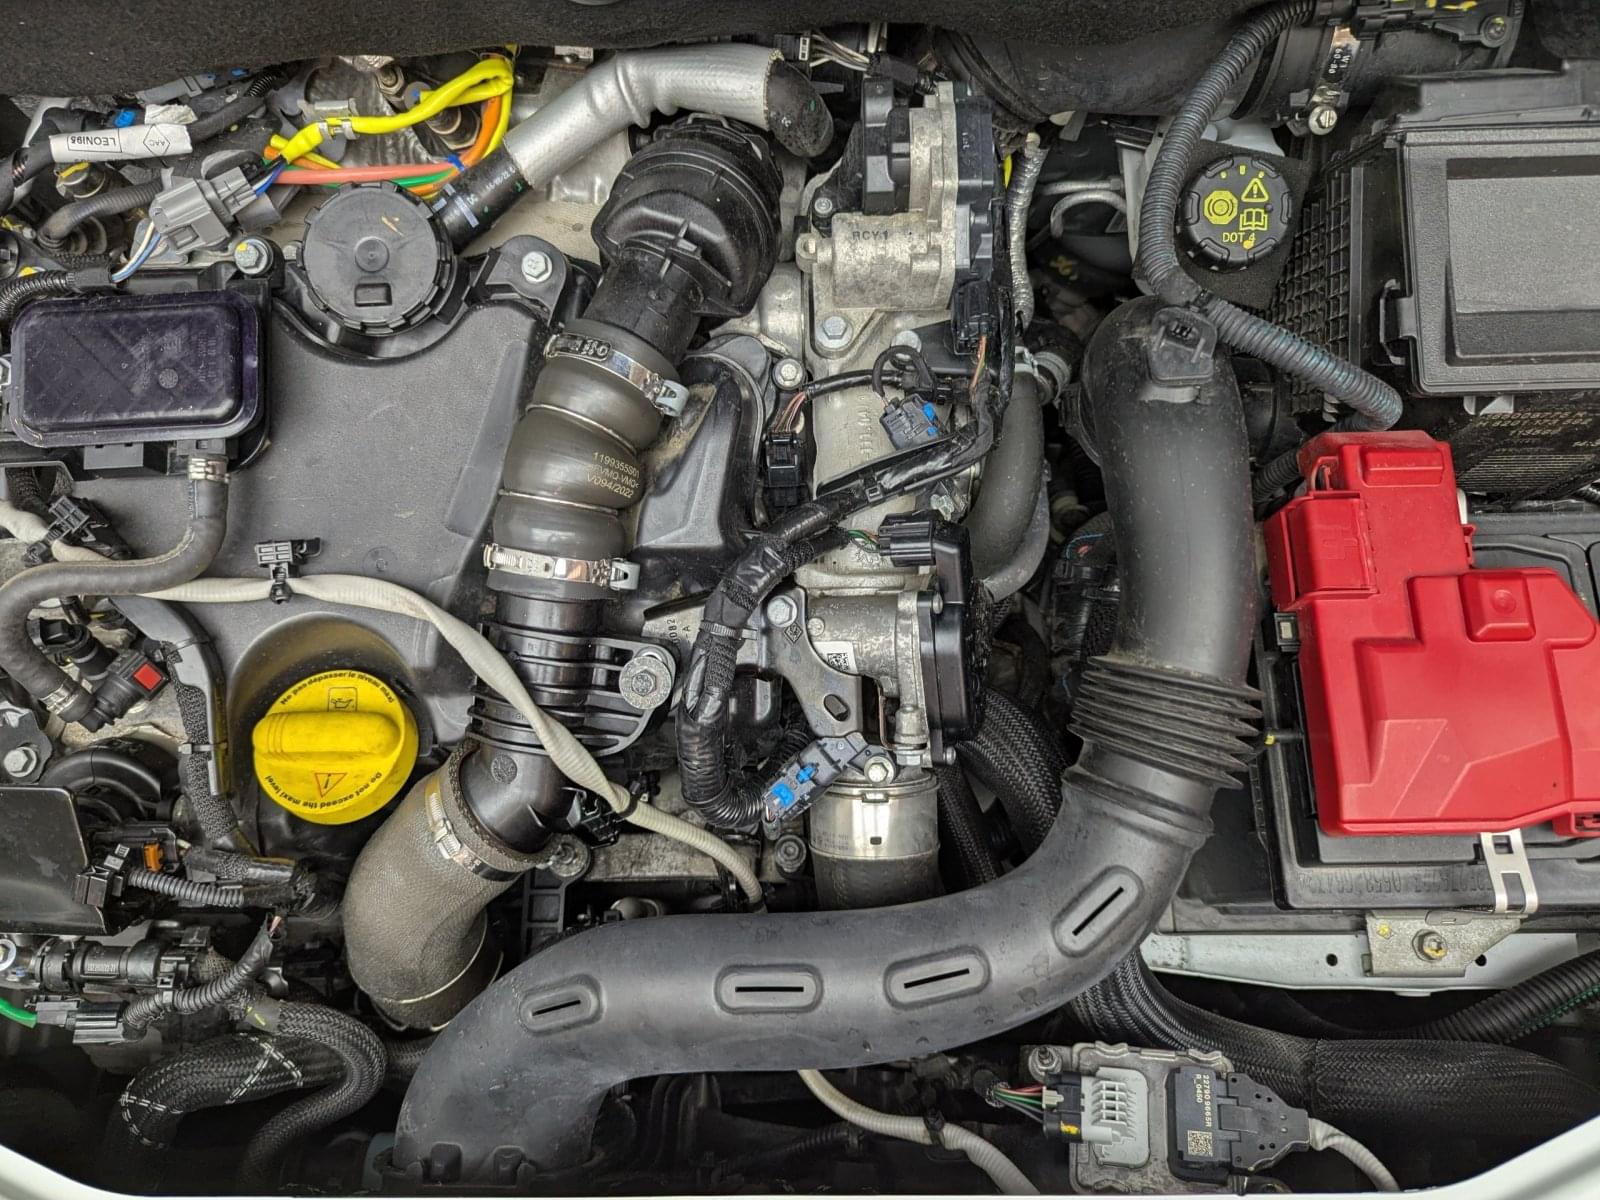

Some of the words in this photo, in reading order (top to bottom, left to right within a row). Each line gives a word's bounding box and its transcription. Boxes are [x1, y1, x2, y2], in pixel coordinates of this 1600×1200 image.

[1222, 232, 1246, 243] DOT
[1248, 232, 1256, 242] 4
[293, 681, 308, 695] pas
[357, 673, 381, 689] niveau
[380, 685, 396, 704] maxi
[370, 771, 382, 782] Do
[265, 775, 281, 795] level
[355, 781, 371, 797] not
[279, 792, 302, 806] maxi
[302, 800, 319, 809] the
[320, 794, 356, 809] exceed
